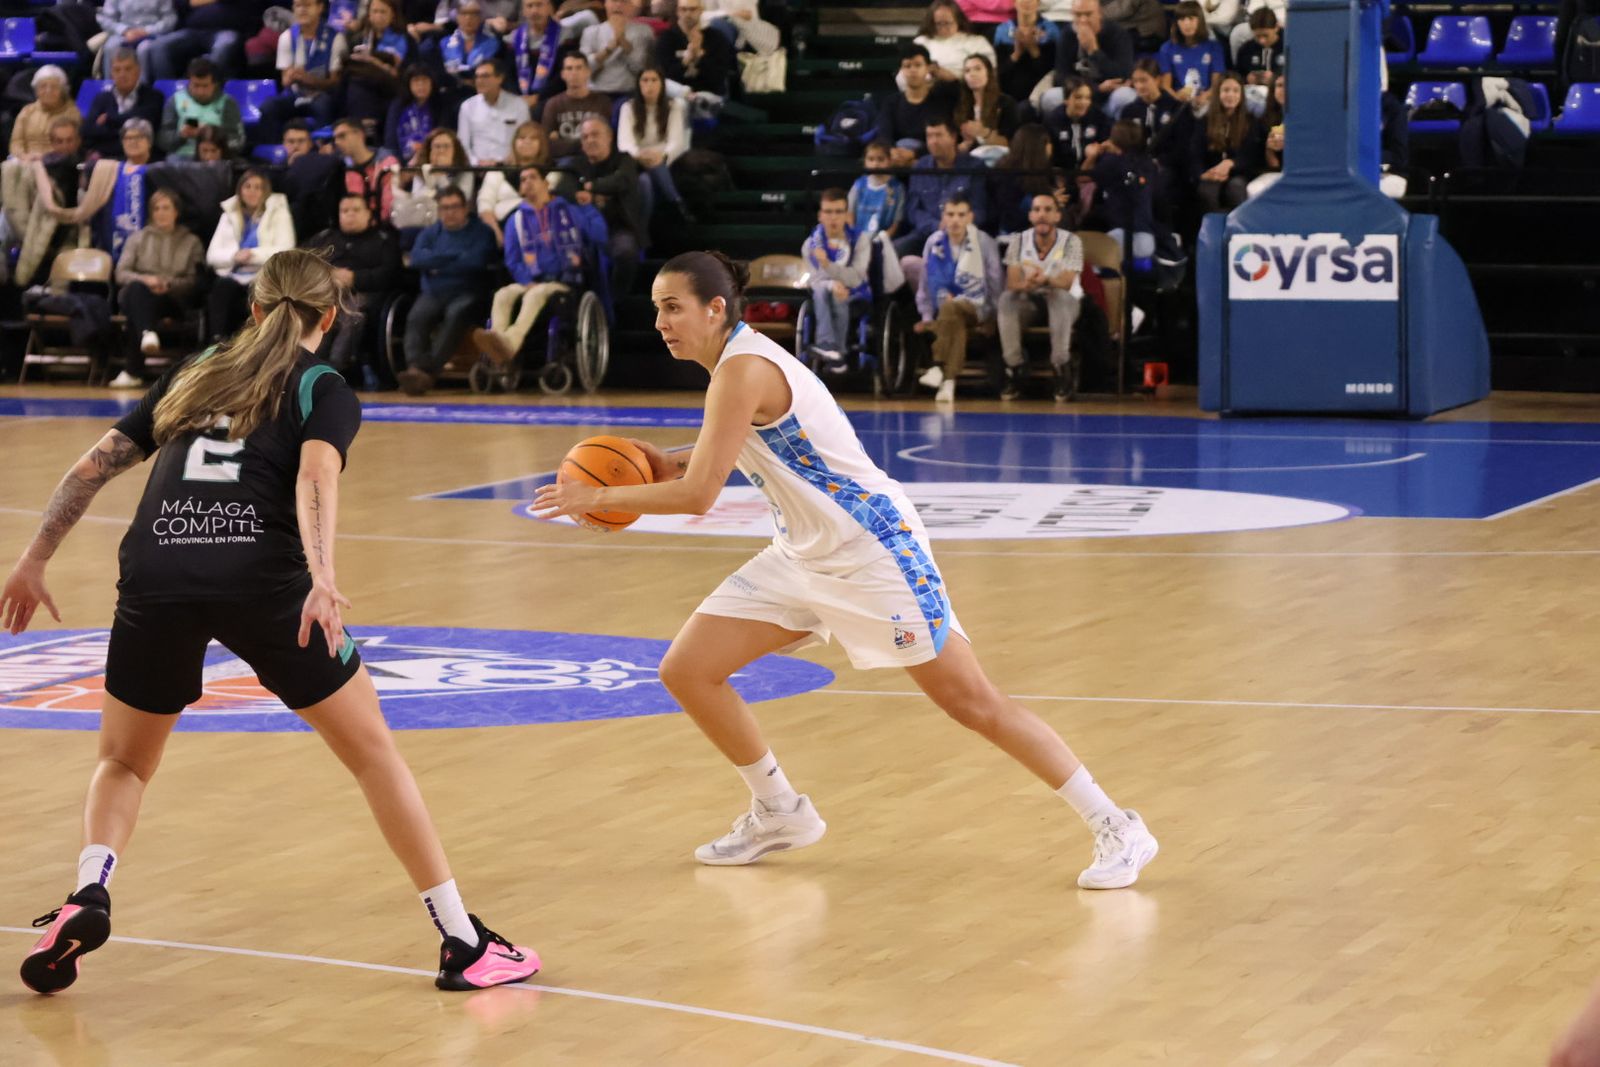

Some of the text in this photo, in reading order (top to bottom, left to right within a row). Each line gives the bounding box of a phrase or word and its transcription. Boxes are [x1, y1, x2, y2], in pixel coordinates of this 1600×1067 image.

[182, 415, 246, 482] 2
[161, 496, 257, 519] MÁLAGA
[153, 516, 264, 535] COMPITE
[158, 535, 257, 546] LA PROVINCIA EN FORMA
